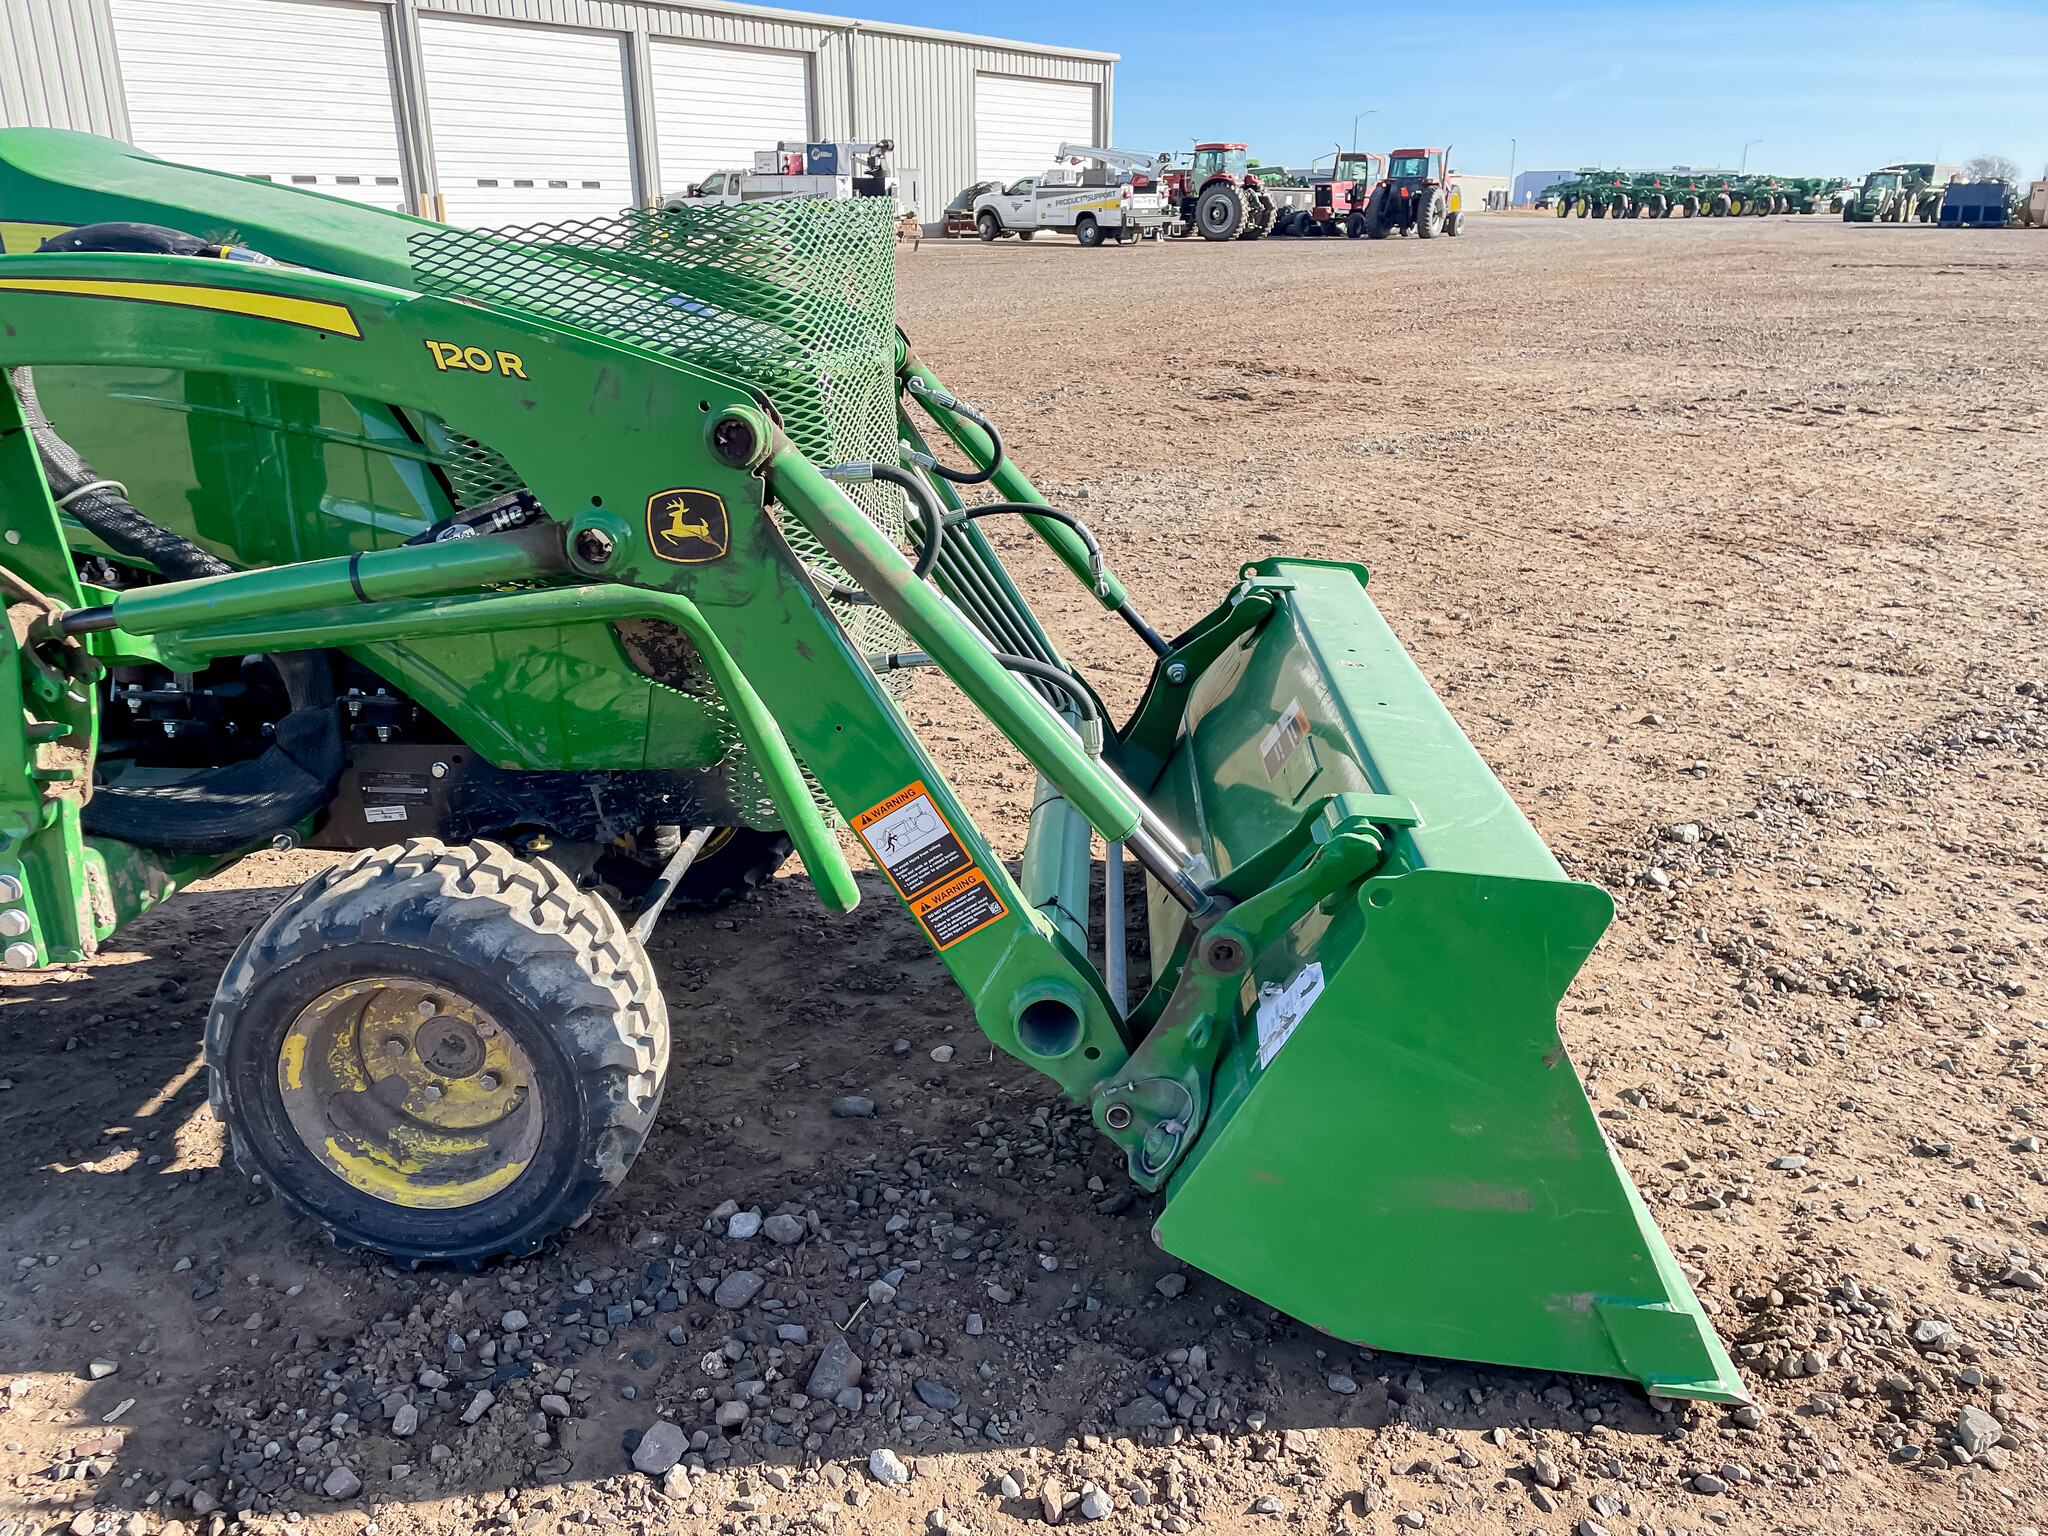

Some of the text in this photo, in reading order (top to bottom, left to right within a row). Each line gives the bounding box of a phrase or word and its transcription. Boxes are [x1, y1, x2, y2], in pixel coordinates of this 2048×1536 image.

[1055, 190, 1116, 207] PRODUCT SUPPORT
[870, 788, 916, 818] WARNING
[931, 875, 977, 904] WARNING
